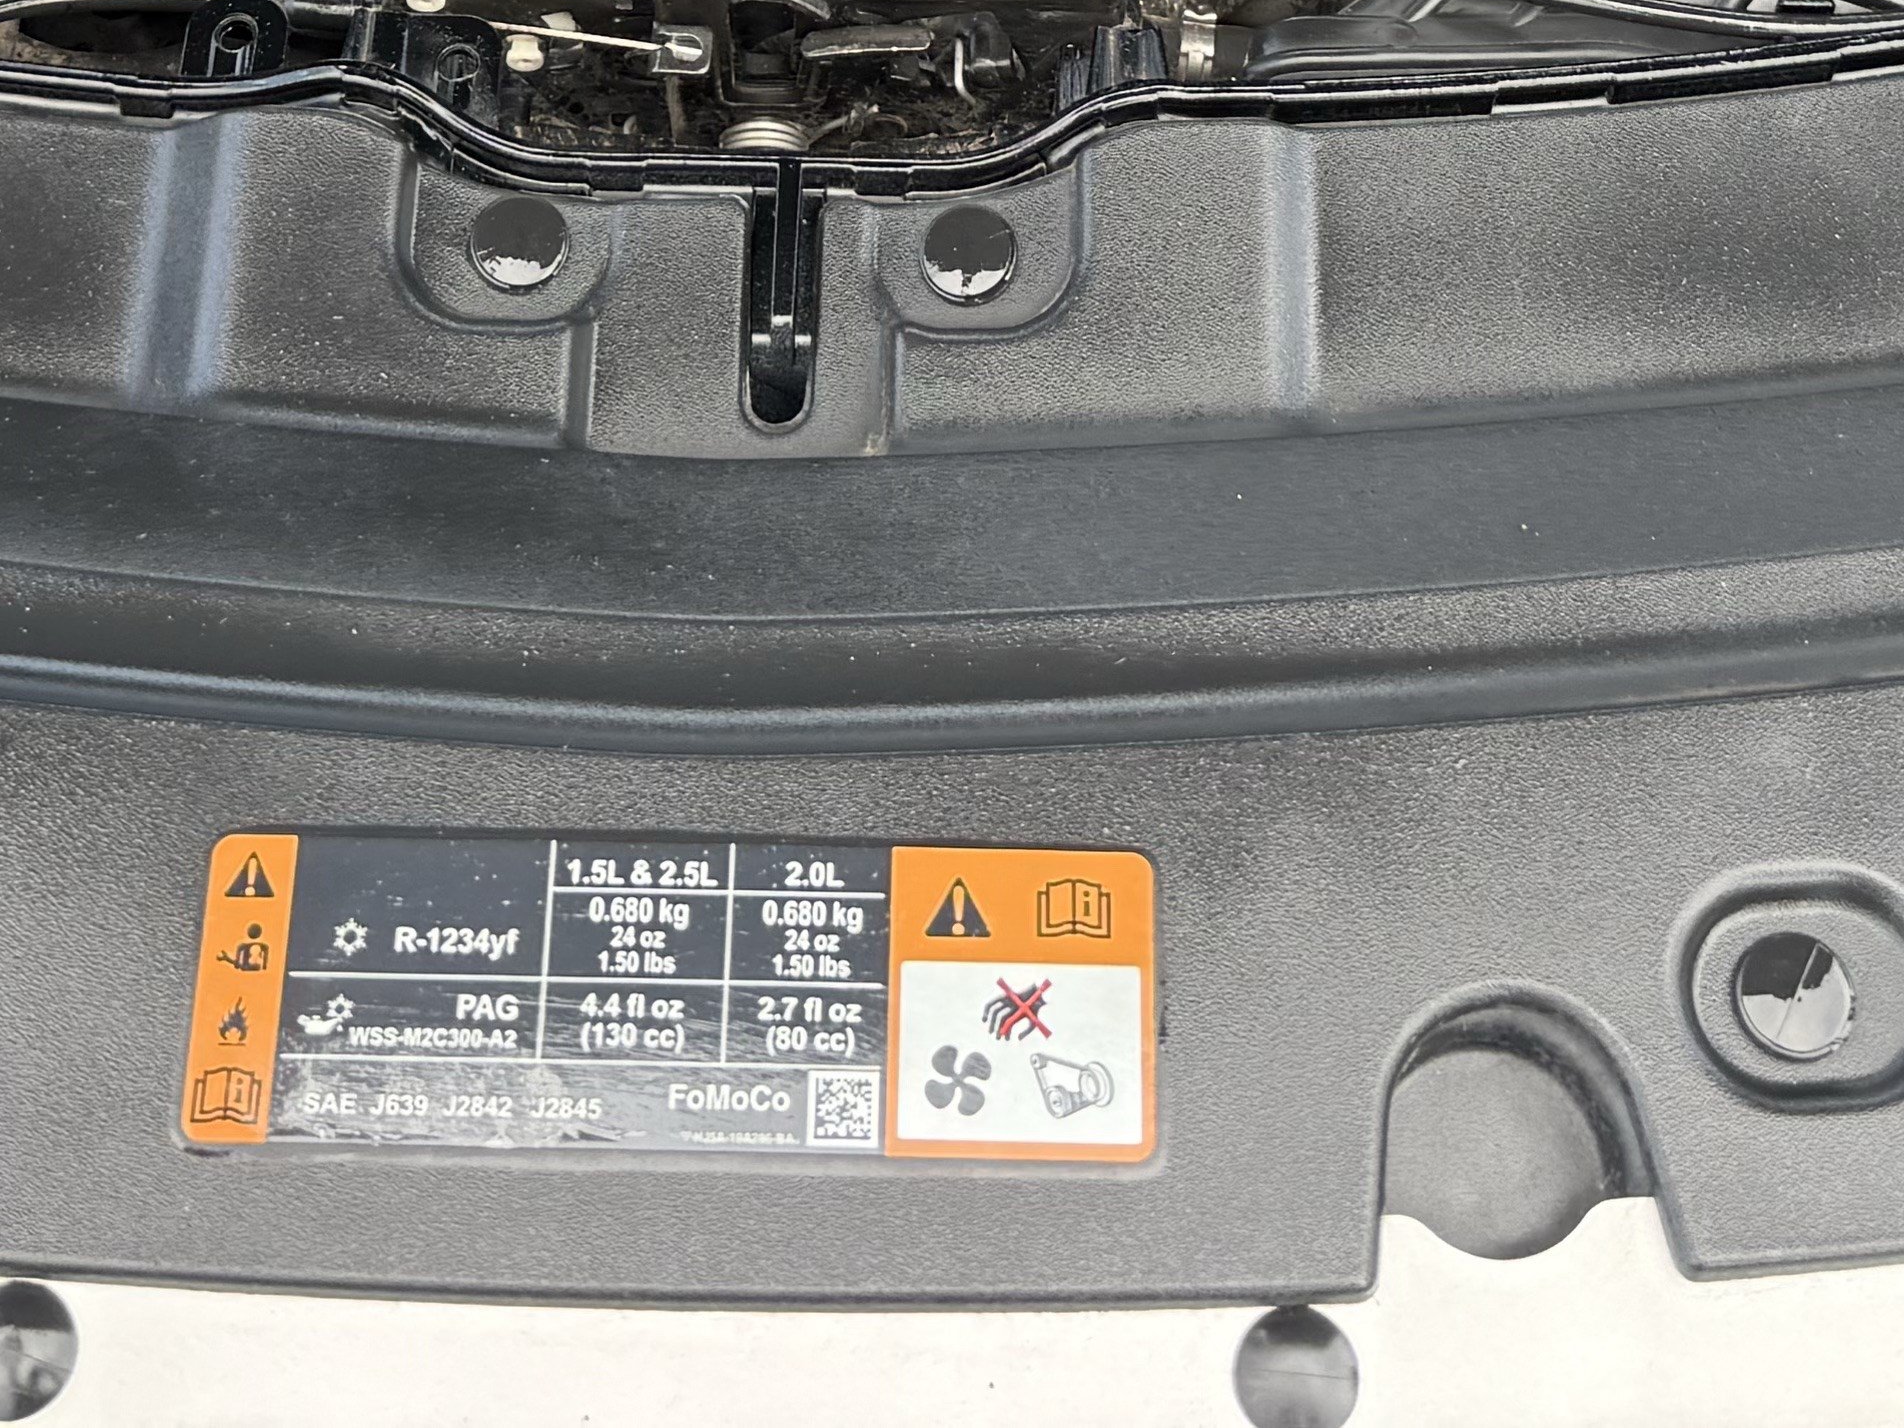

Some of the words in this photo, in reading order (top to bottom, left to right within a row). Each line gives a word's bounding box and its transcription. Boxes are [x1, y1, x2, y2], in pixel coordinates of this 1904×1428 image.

[567, 858, 624, 886] 1.5L
[630, 860, 652, 886] &
[659, 860, 719, 888] 2.5L
[785, 861, 845, 888] 2.0L
[589, 896, 653, 923] 0.680
[659, 898, 690, 931] kg
[762, 899, 826, 927] 0.680
[832, 900, 864, 935] kg
[394, 926, 521, 962] R-1234yf
[609, 925, 636, 948] 24
[640, 931, 667, 949] oz
[784, 929, 810, 952] 24
[814, 934, 840, 953] oz
[598, 950, 640, 973] 1.50
[644, 951, 676, 974] lbs
[772, 954, 813, 977] 1.50
[818, 955, 851, 978] lbs
[456, 994, 520, 1021] PAG
[579, 992, 621, 1018] 4.4
[627, 992, 646, 1019] fl
[651, 998, 685, 1019] oz
[757, 996, 798, 1022] 2.7
[804, 996, 823, 1022] fl
[828, 1002, 862, 1023] oz
[349, 1025, 518, 1049] WSS-M2C300-A2
[580, 1022, 637, 1054] (130
[643, 1023, 685, 1055] cc)
[765, 1025, 807, 1057] (80
[814, 1026, 855, 1058] cc)
[303, 1092, 358, 1115] SAE
[369, 1094, 429, 1116] J639
[443, 1096, 513, 1118] J2842
[530, 1097, 603, 1119] J2845
[668, 1084, 791, 1112] FoMoCo
